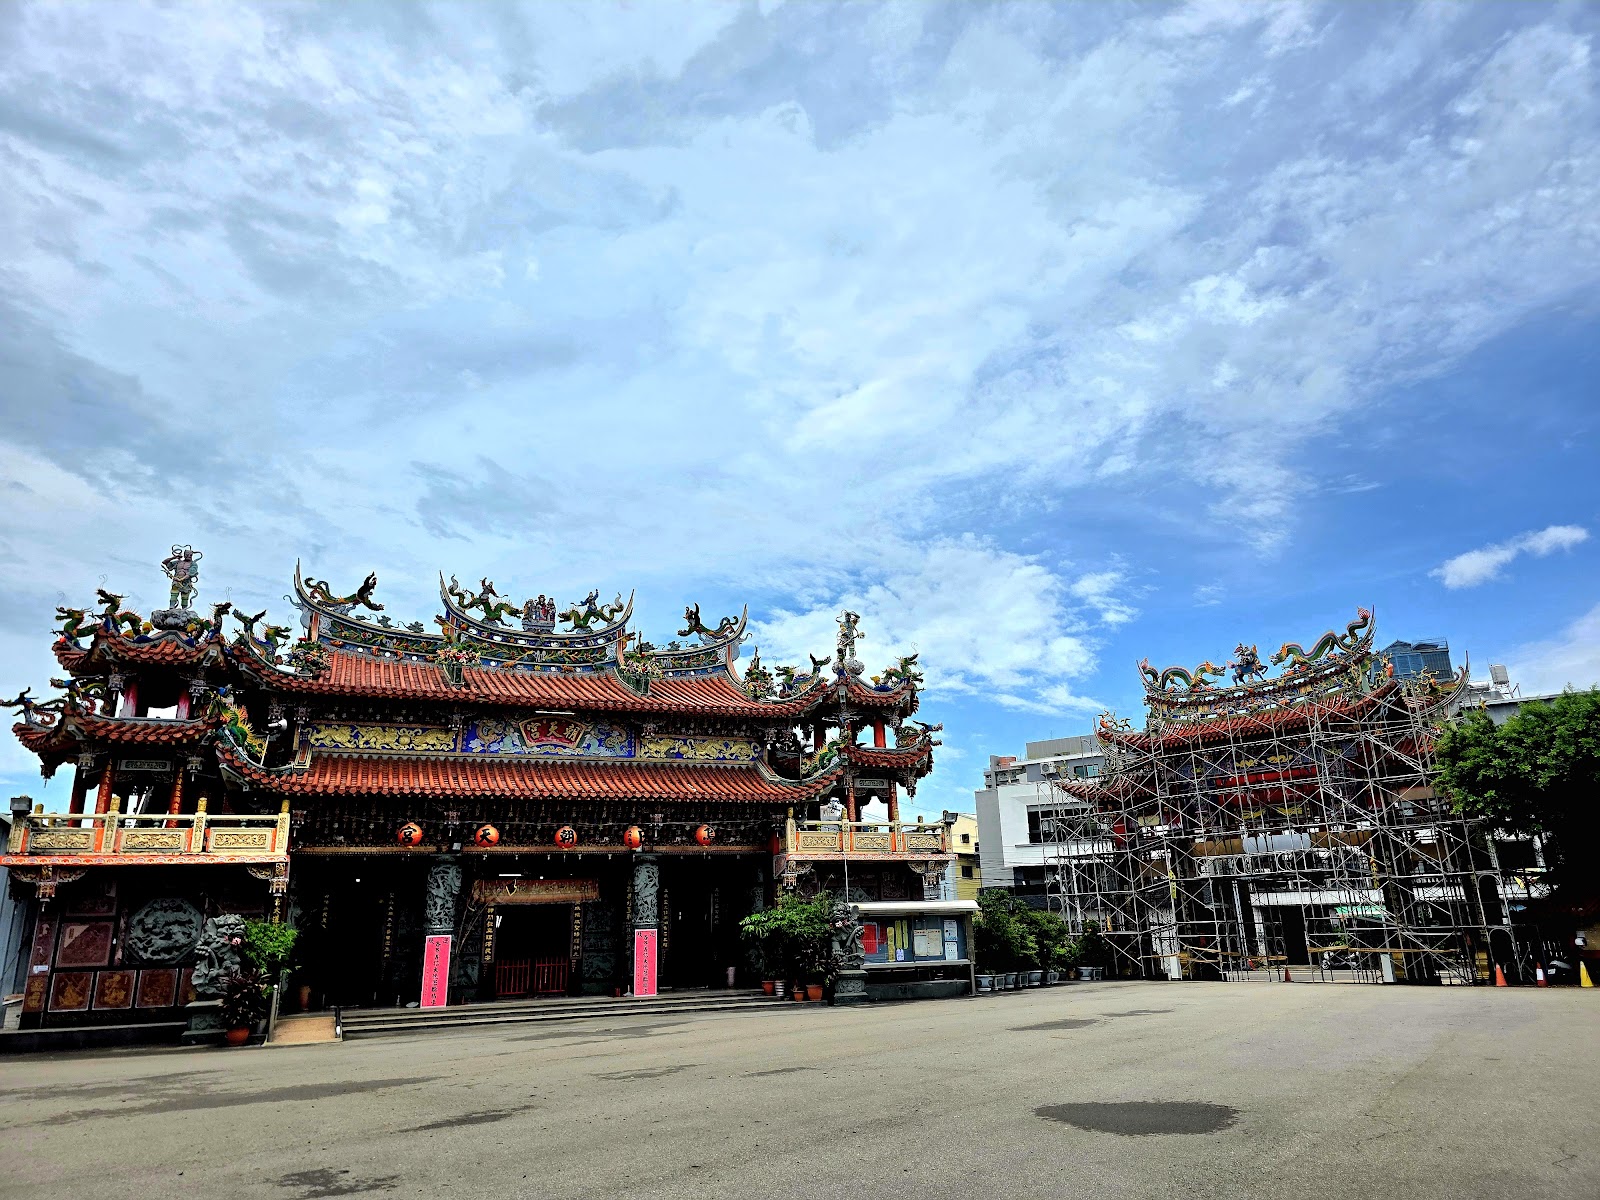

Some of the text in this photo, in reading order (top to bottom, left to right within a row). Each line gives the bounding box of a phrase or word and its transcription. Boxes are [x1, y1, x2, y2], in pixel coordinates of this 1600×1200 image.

[526, 720, 581, 742] 朝天宮
[400, 826, 417, 843] 宮
[479, 828, 494, 844] 天
[559, 829, 574, 845] 朝
